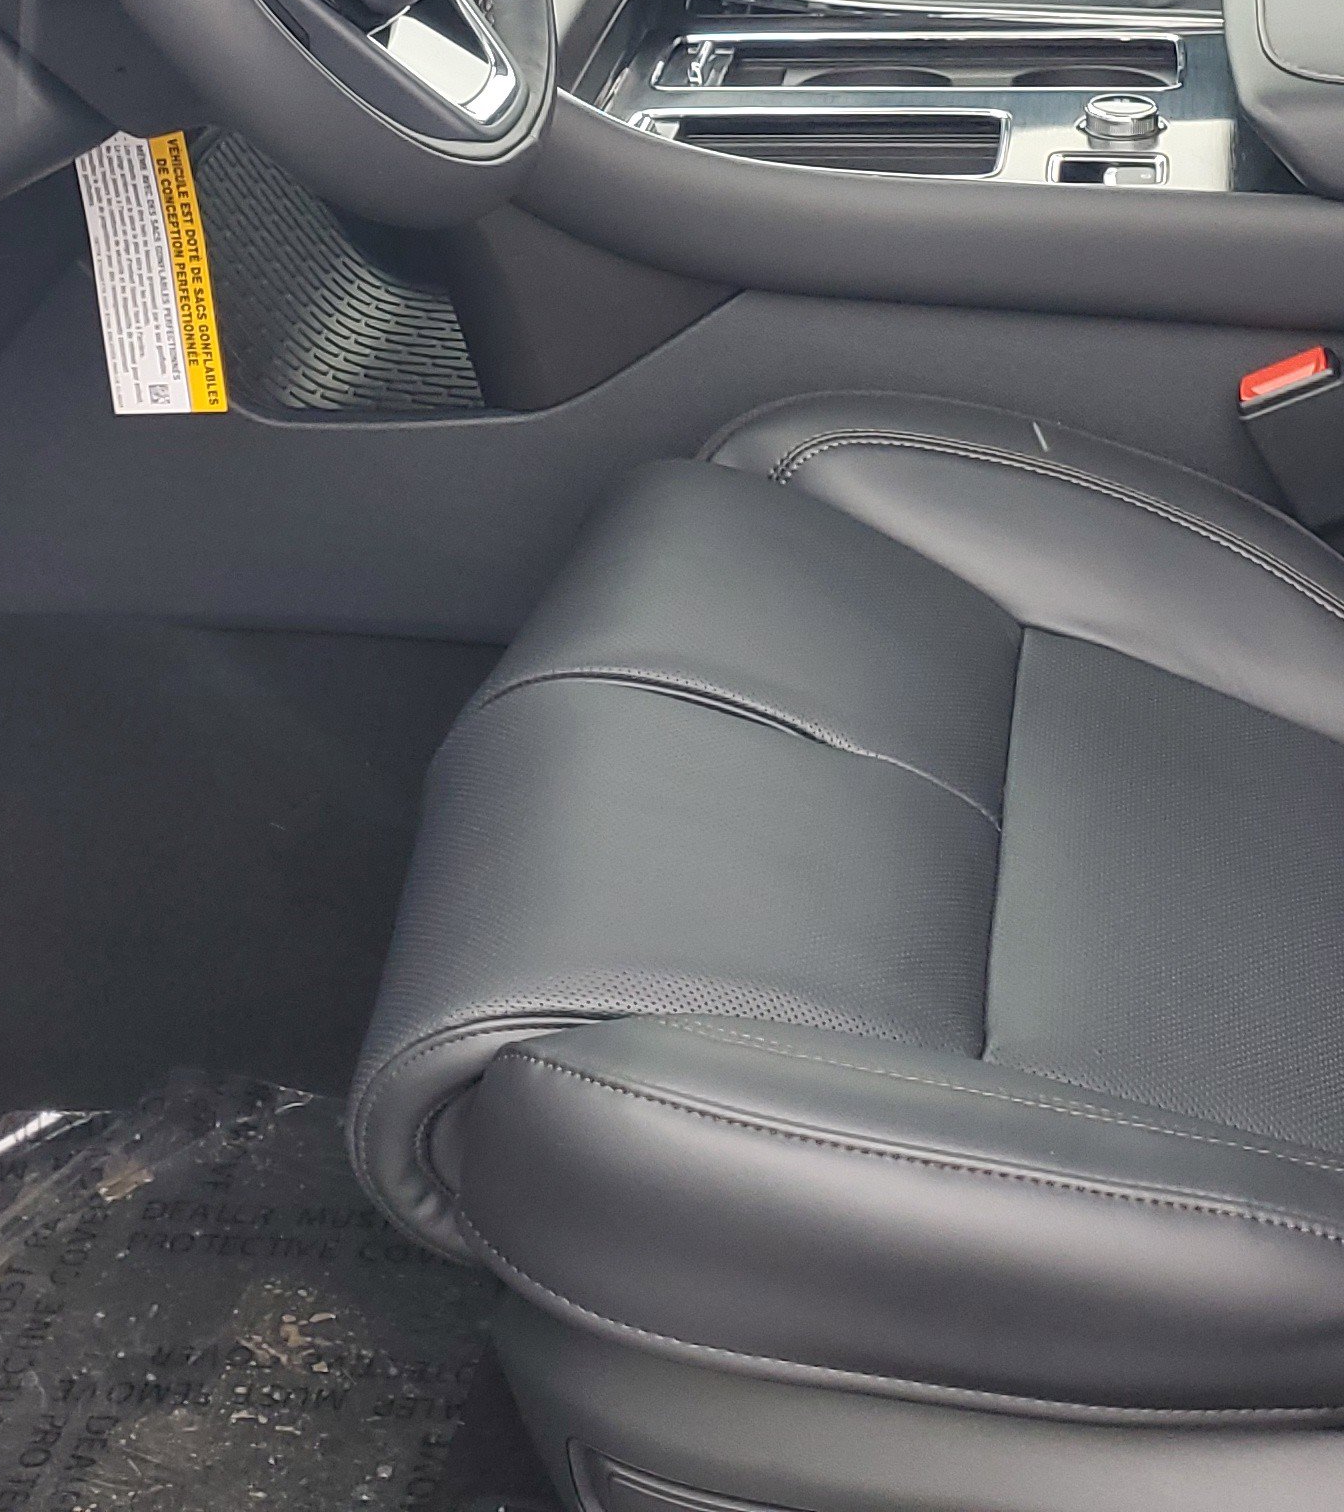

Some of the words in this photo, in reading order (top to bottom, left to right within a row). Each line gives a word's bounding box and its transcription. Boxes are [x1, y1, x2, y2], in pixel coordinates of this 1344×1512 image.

[156, 158, 169, 175] DE
[167, 138, 188, 199] VÉHICULE
[160, 179, 184, 258] CONCEPTION
[180, 203, 193, 225] EST
[185, 229, 202, 263] DOTÉ
[190, 267, 203, 284] DE
[175, 262, 199, 366] PERFECTIONNÉE
[194, 287, 207, 320] SACS
[198, 324, 219, 405] GONFLABLES
